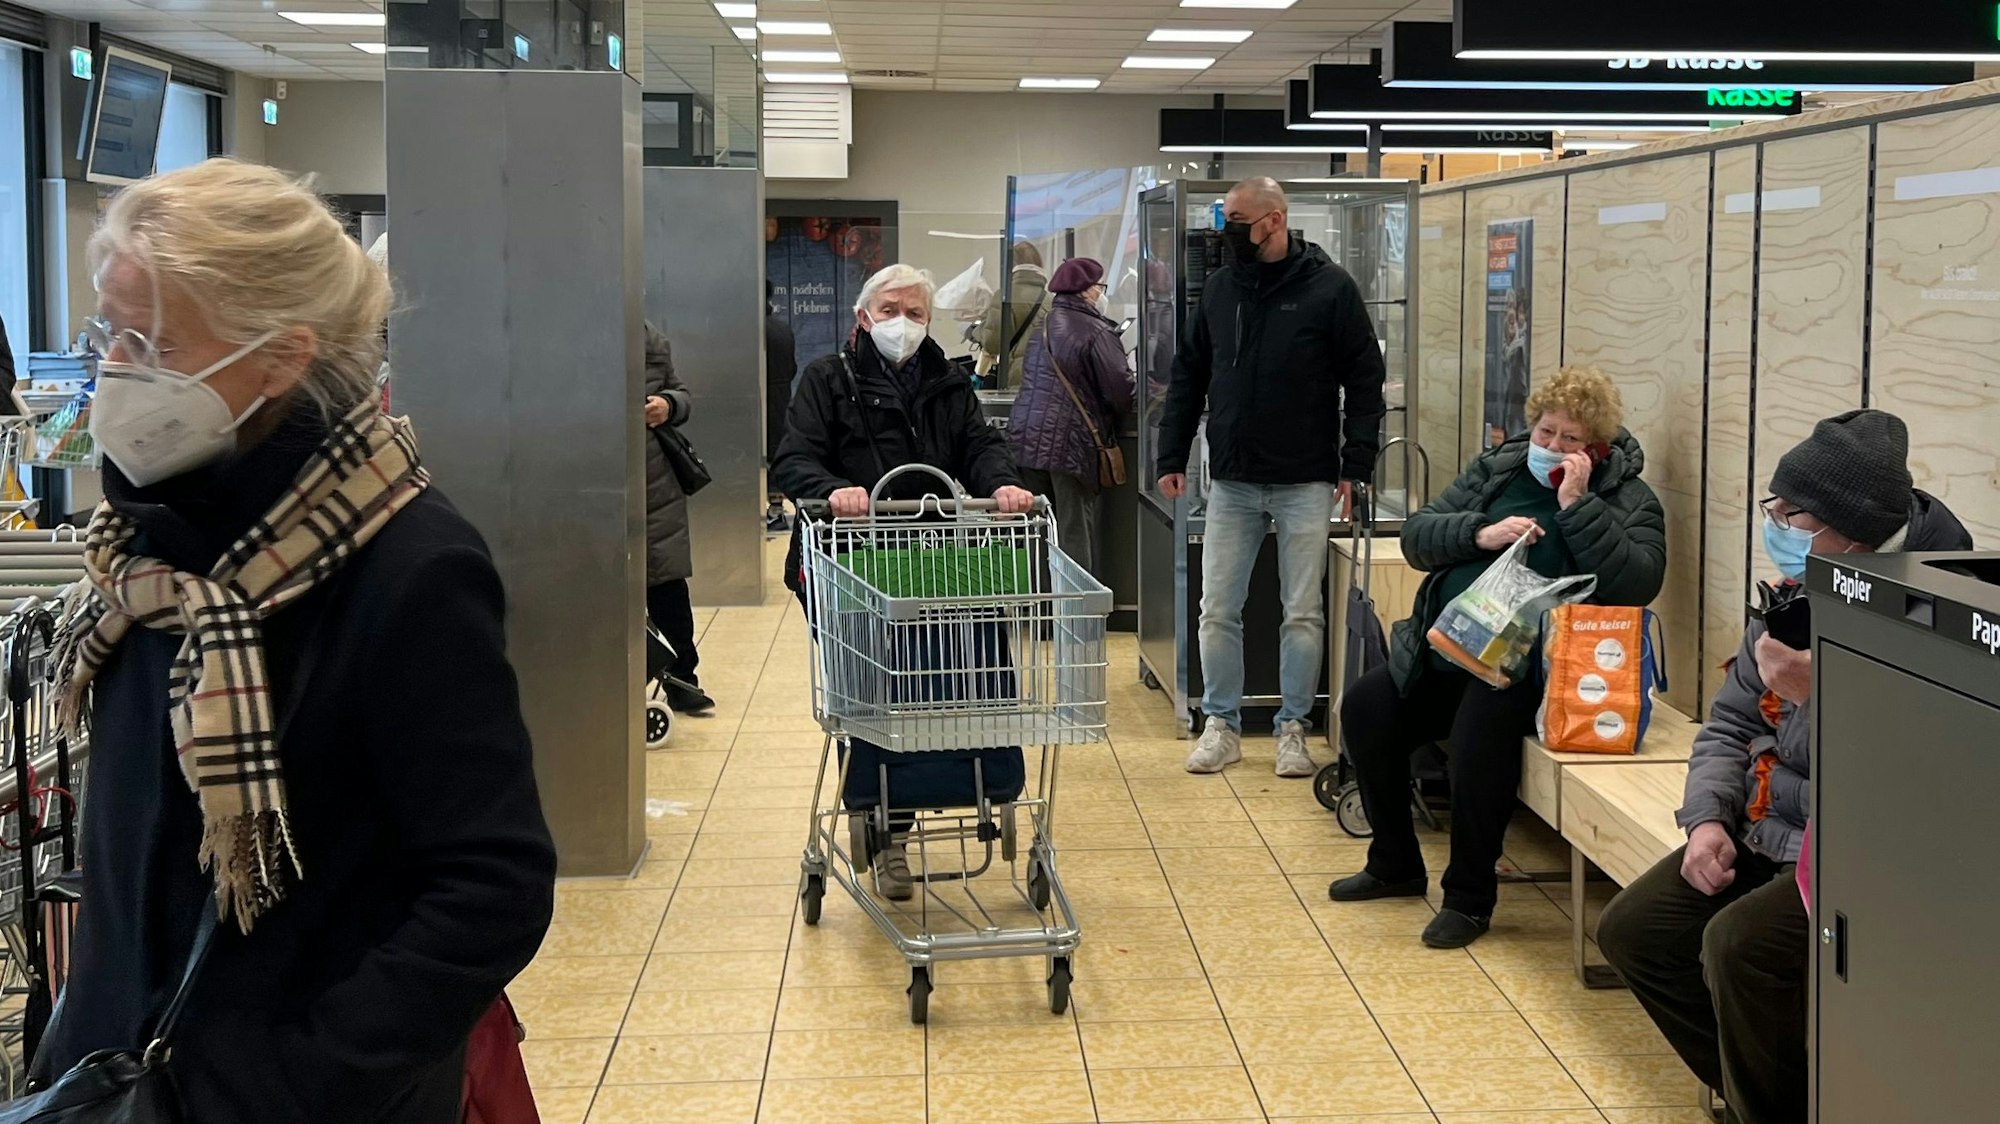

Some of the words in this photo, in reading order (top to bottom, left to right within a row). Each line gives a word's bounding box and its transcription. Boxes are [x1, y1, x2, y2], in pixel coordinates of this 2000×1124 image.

[1707, 87, 1794, 107] Kasse
[1833, 567, 1872, 604] Papier
[1572, 620, 1598, 632] Gute
[1972, 612, 2000, 655] Pap
